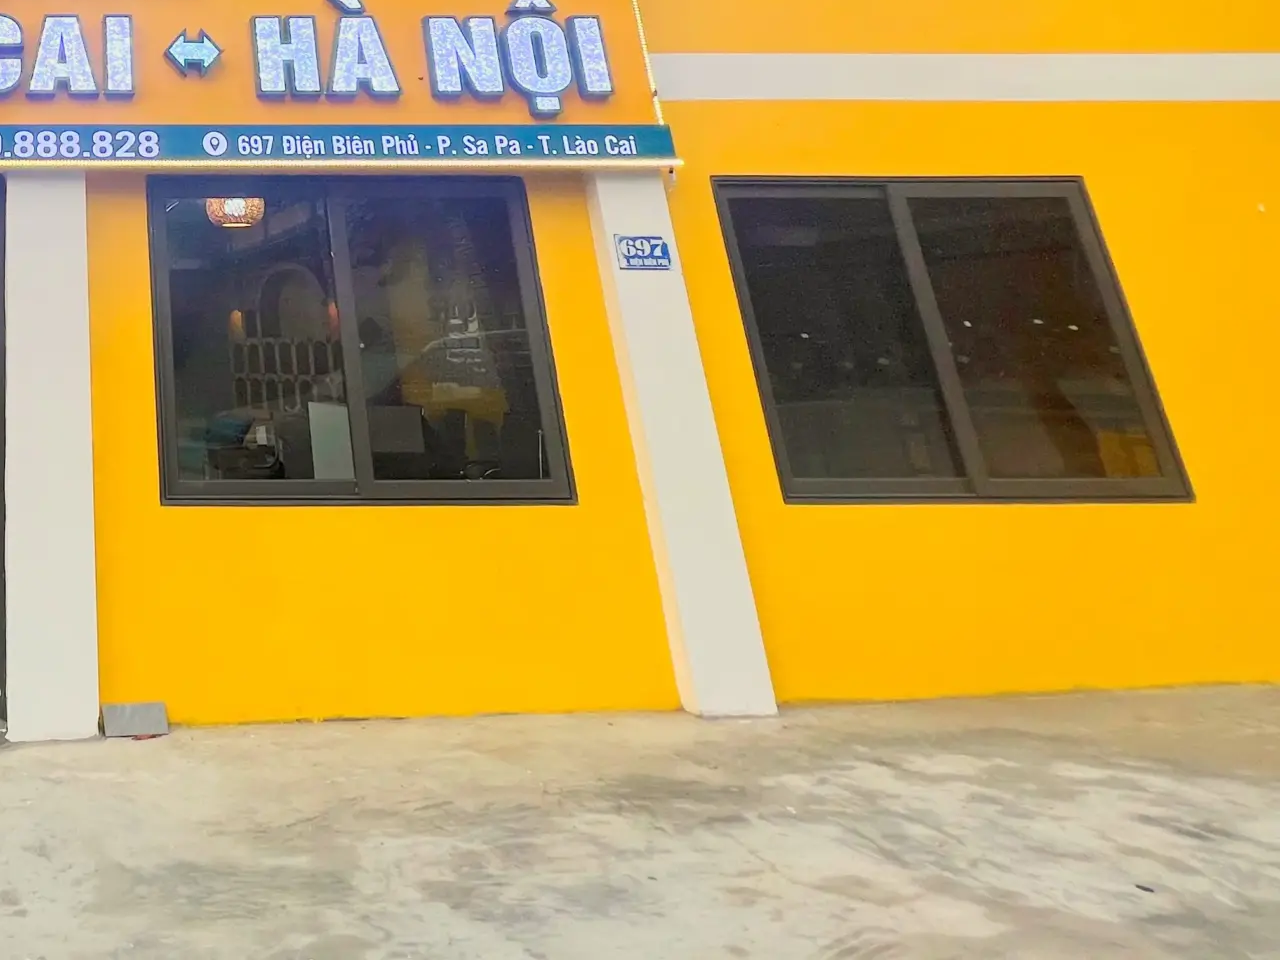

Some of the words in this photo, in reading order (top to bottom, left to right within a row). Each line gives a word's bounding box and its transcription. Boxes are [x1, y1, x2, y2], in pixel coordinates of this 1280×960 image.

[237, 135, 273, 155] 697
[282, 135, 325, 158] Điện
[332, 135, 375, 155] Biên
[381, 133, 419, 155] Phủ
[437, 135, 457, 155] P.
[462, 135, 489, 155] Sa
[494, 135, 521, 155] Pa
[537, 135, 558, 155] T.
[562, 135, 599, 155] Lào
[604, 135, 637, 155] Cai
[620, 239, 663, 257] 697
